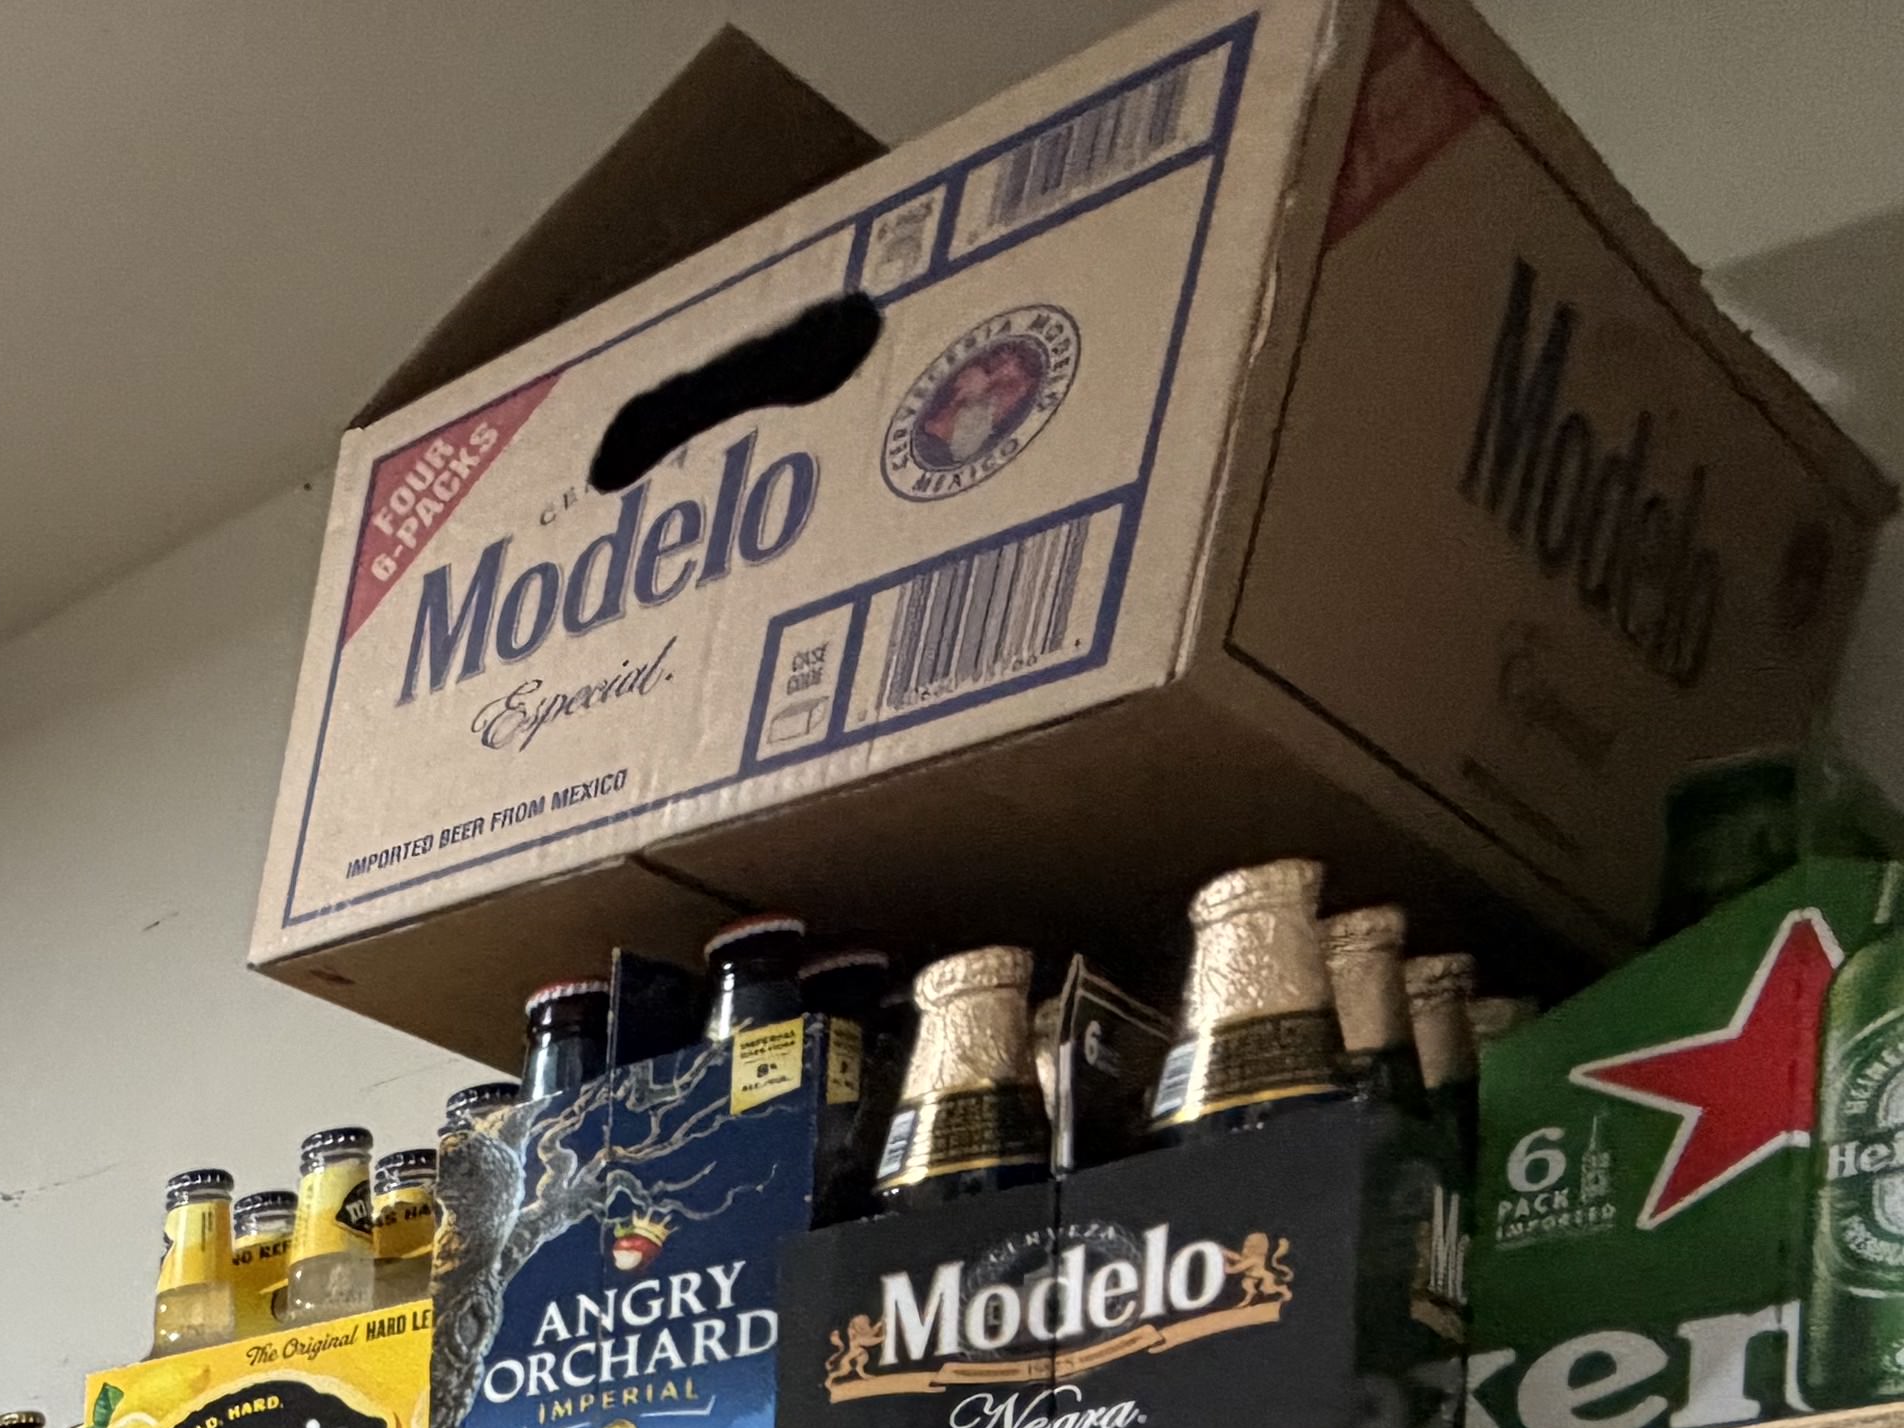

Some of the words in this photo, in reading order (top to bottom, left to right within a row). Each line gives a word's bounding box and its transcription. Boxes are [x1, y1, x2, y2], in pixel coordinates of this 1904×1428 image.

[370, 421, 499, 582] 6-PACKS
[372, 425, 456, 533] FOUR
[394, 428, 820, 709] Modelo
[345, 832, 434, 879] IMPORTED
[439, 816, 484, 850] BEER
[490, 796, 546, 835] FROM
[553, 769, 628, 820] MEXICO
[1498, 1188, 1571, 1218] PACK
[1506, 1127, 1567, 1193] 6
[1495, 1204, 1616, 1242] IMPORTED
[246, 1346, 278, 1366] The
[282, 1325, 358, 1361] Original
[366, 1313, 406, 1342] HARD
[533, 1260, 746, 1347] ANGRY
[879, 1222, 1228, 1367] Modelo
[484, 1308, 780, 1403] ORCHARD
[538, 1377, 701, 1426] IMPERIAL
